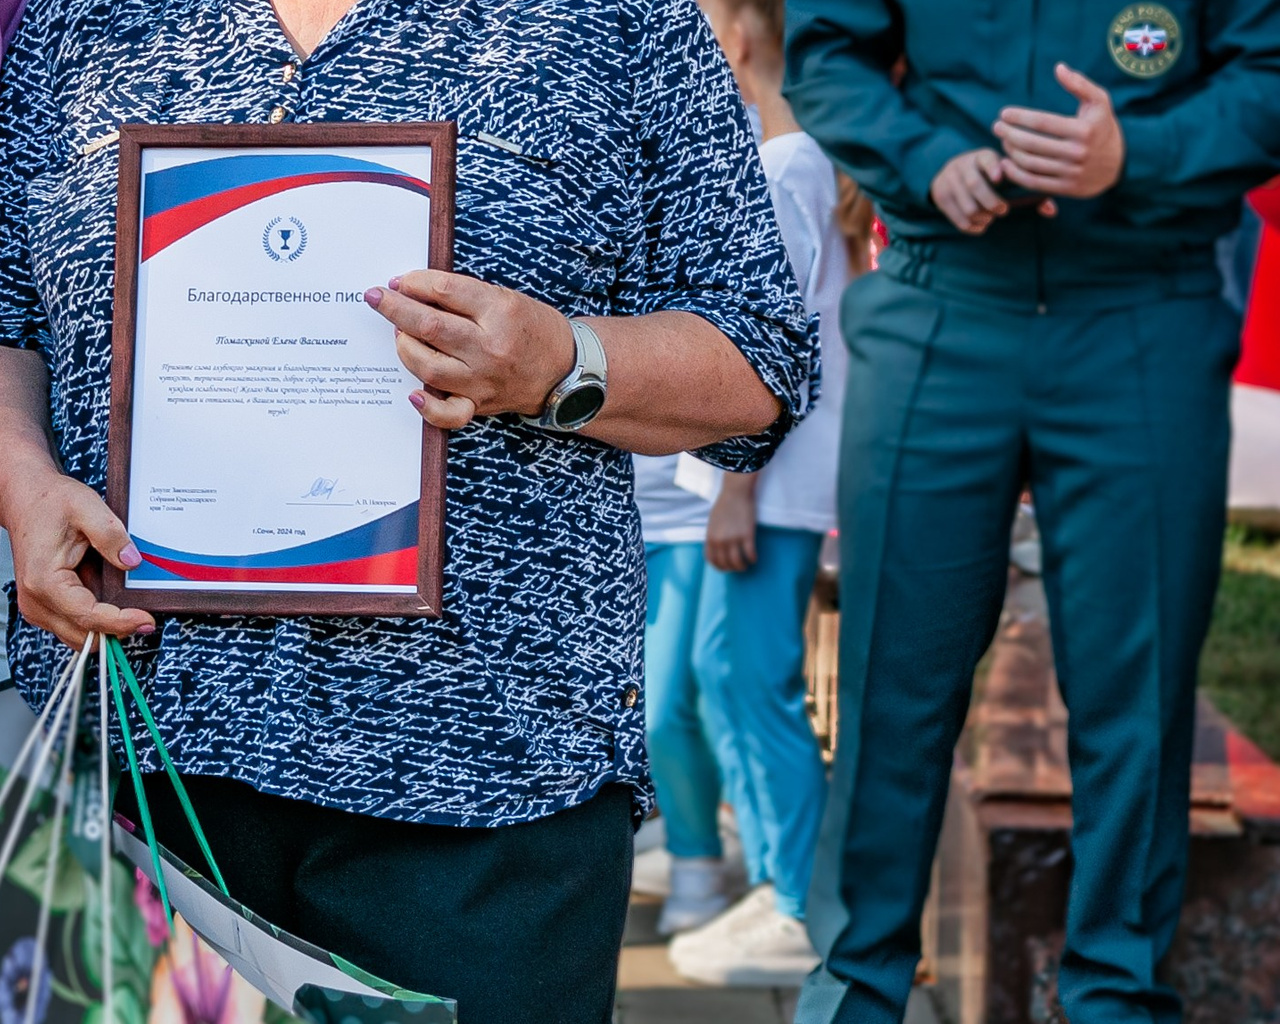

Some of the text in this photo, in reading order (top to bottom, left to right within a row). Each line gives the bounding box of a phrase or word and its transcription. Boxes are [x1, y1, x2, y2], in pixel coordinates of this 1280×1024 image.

[187, 287, 369, 306] Благодарственное пис
[272, 336, 297, 346] Елене
[299, 336, 348, 346] Васильевне
